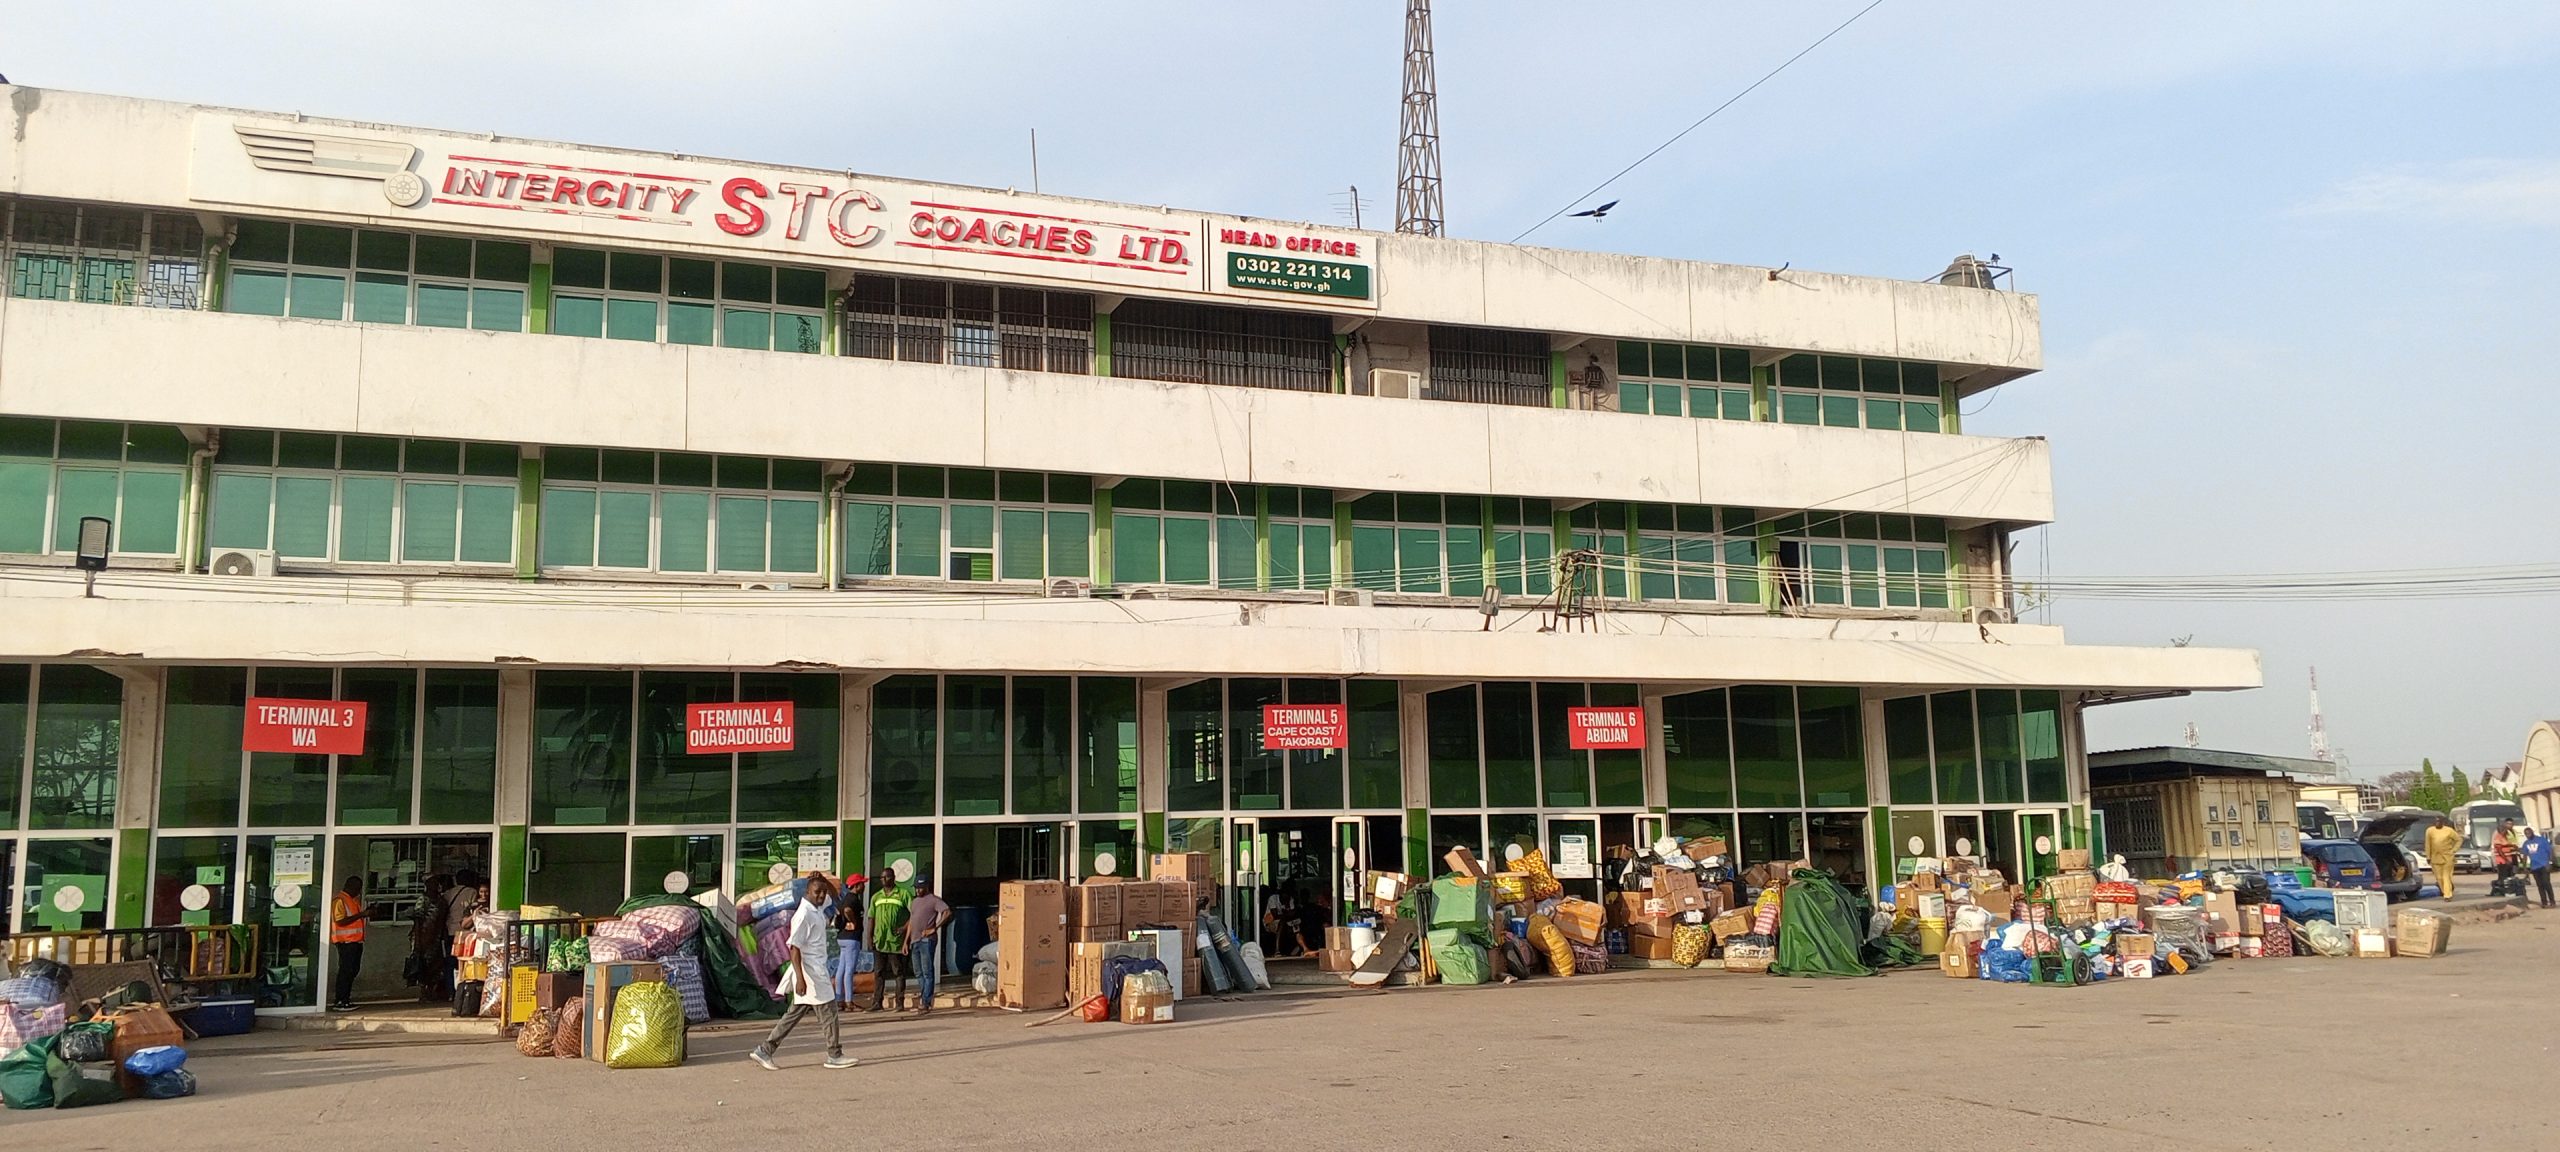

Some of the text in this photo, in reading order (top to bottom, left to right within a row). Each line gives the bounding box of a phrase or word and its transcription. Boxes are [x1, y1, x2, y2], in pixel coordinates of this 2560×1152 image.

[441, 166, 1189, 265] INTERCITY STC COACHES LTD.
[1220, 228, 1357, 257] HEAD OFFICE
[1236, 257, 1352, 281] 0302 221 314
[1236, 274, 1331, 293] www.stc.gov.gh
[258, 705, 354, 728] TERMINAL 3
[698, 707, 784, 727] TERMINAL 4
[1271, 709, 1338, 725] TERMINAL 5
[1575, 711, 1636, 727] TERMINAL 6
[292, 727, 317, 747] WA
[689, 726, 791, 747] OUAGADOUGOU
[1267, 727, 1298, 737] CAPE
[1299, 726, 1336, 736] COAST
[1586, 727, 1629, 743] ABIDJAN
[1278, 737, 1333, 747] TAKORADI
